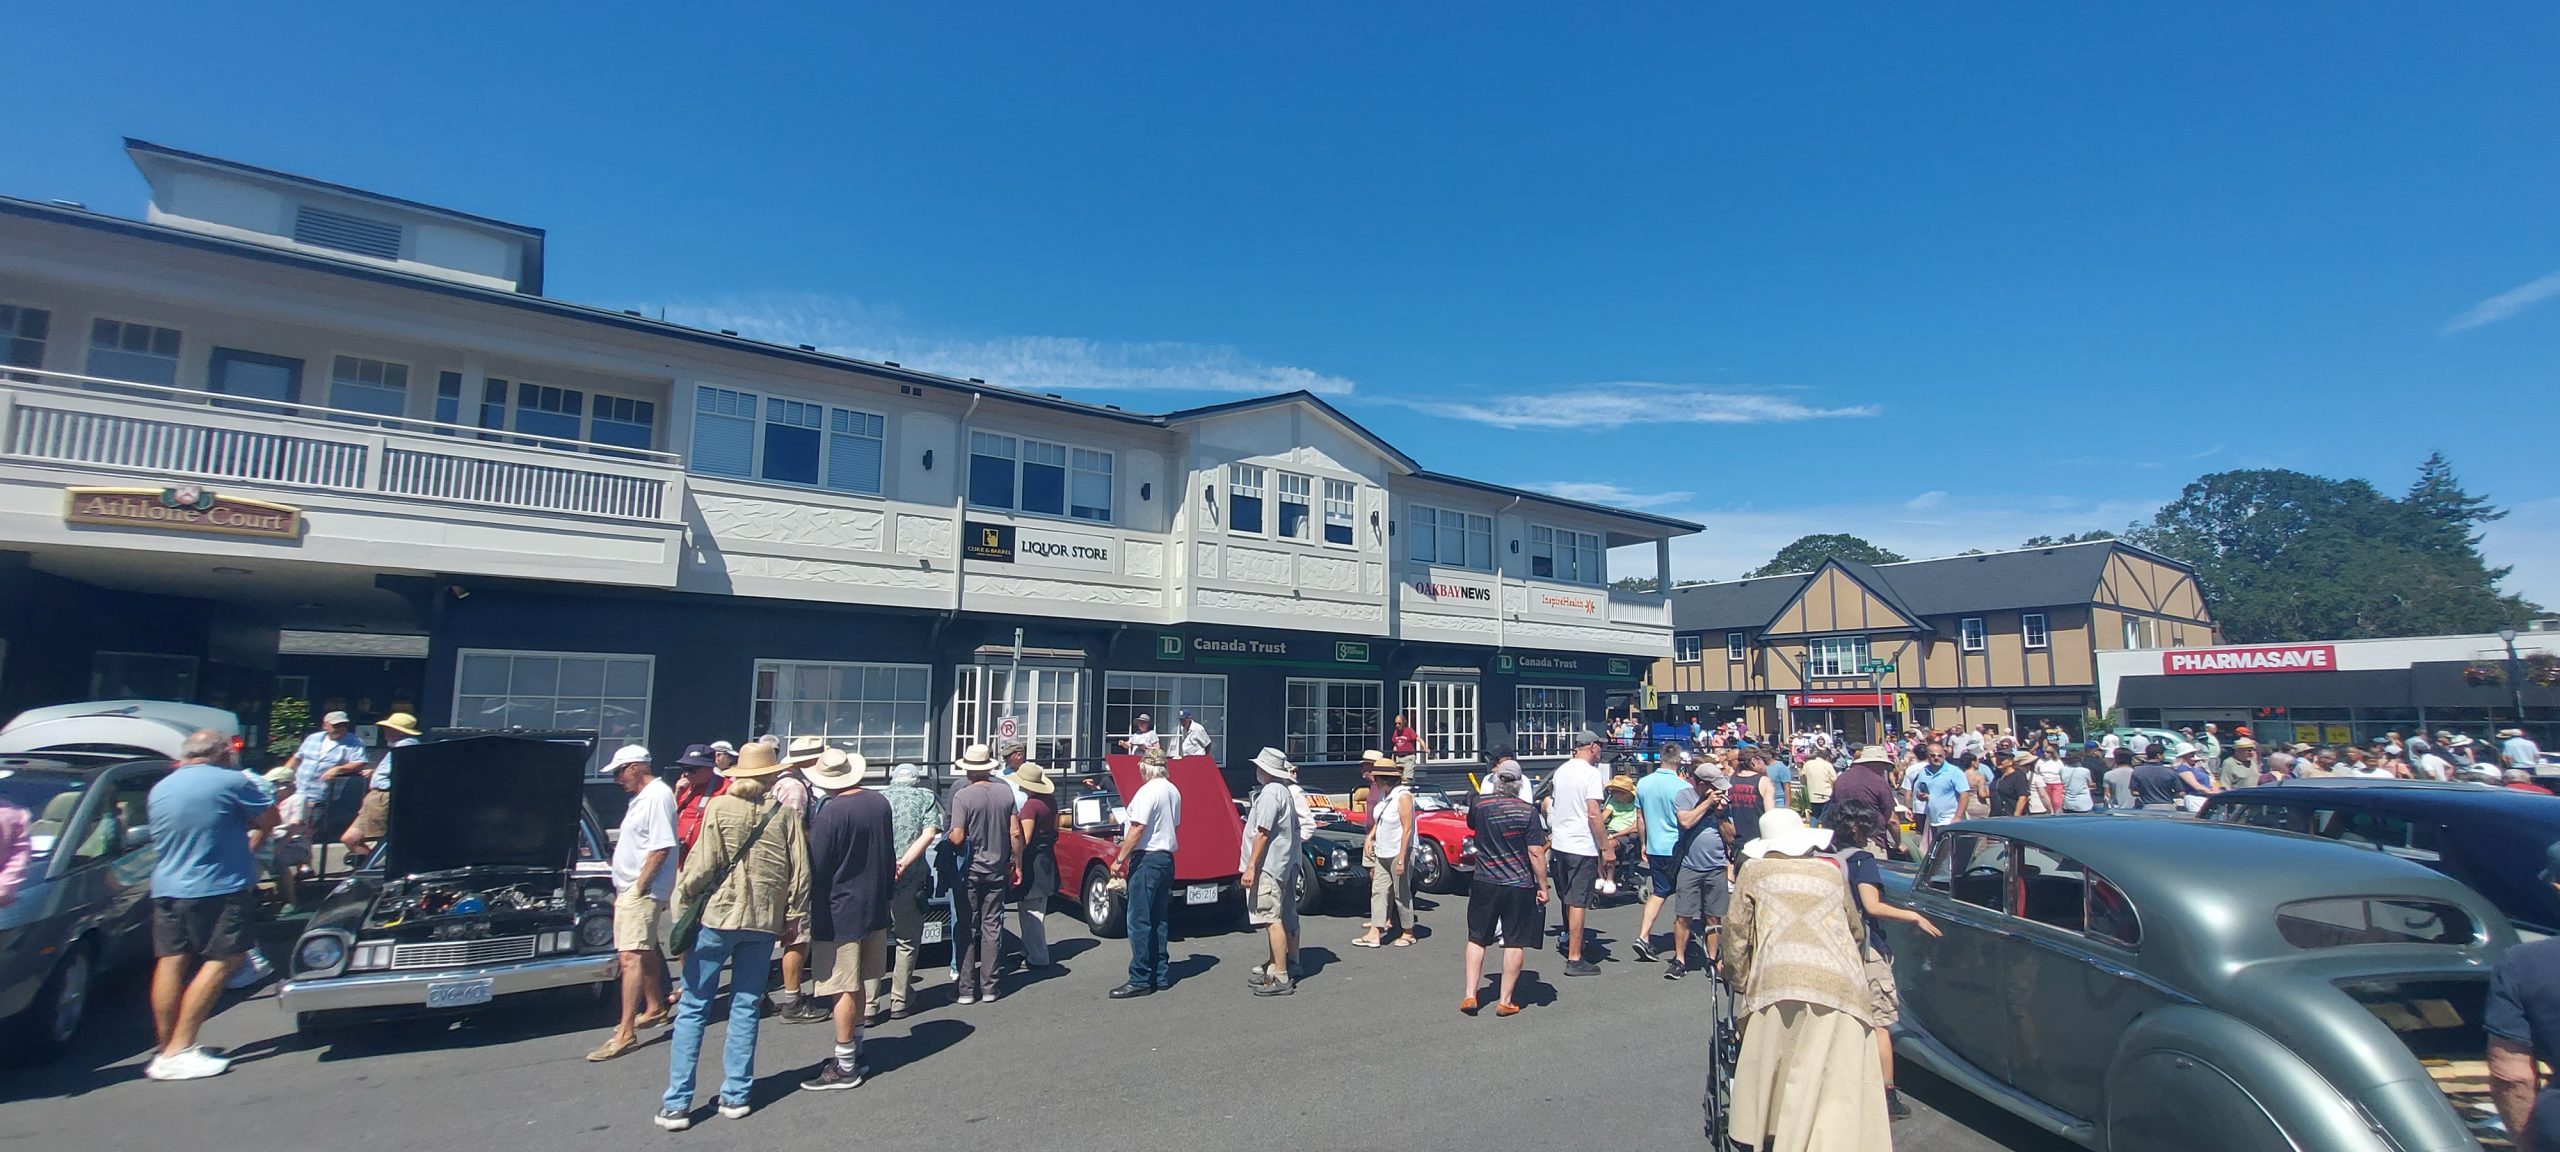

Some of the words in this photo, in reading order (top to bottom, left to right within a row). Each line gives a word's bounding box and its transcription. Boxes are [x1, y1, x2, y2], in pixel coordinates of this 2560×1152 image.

[82, 496, 200, 523] Athlone
[207, 506, 282, 531] Court
[1021, 540, 1069, 557] LIQUOR
[1072, 545, 1108, 560] STORE
[1160, 636, 1182, 654] TD
[1193, 637, 1246, 652] Canada
[1249, 640, 1286, 654] Trust
[1519, 656, 1552, 668] Canada
[1553, 658, 1578, 669] Trust
[2172, 649, 2327, 671] PHARMASAVE
